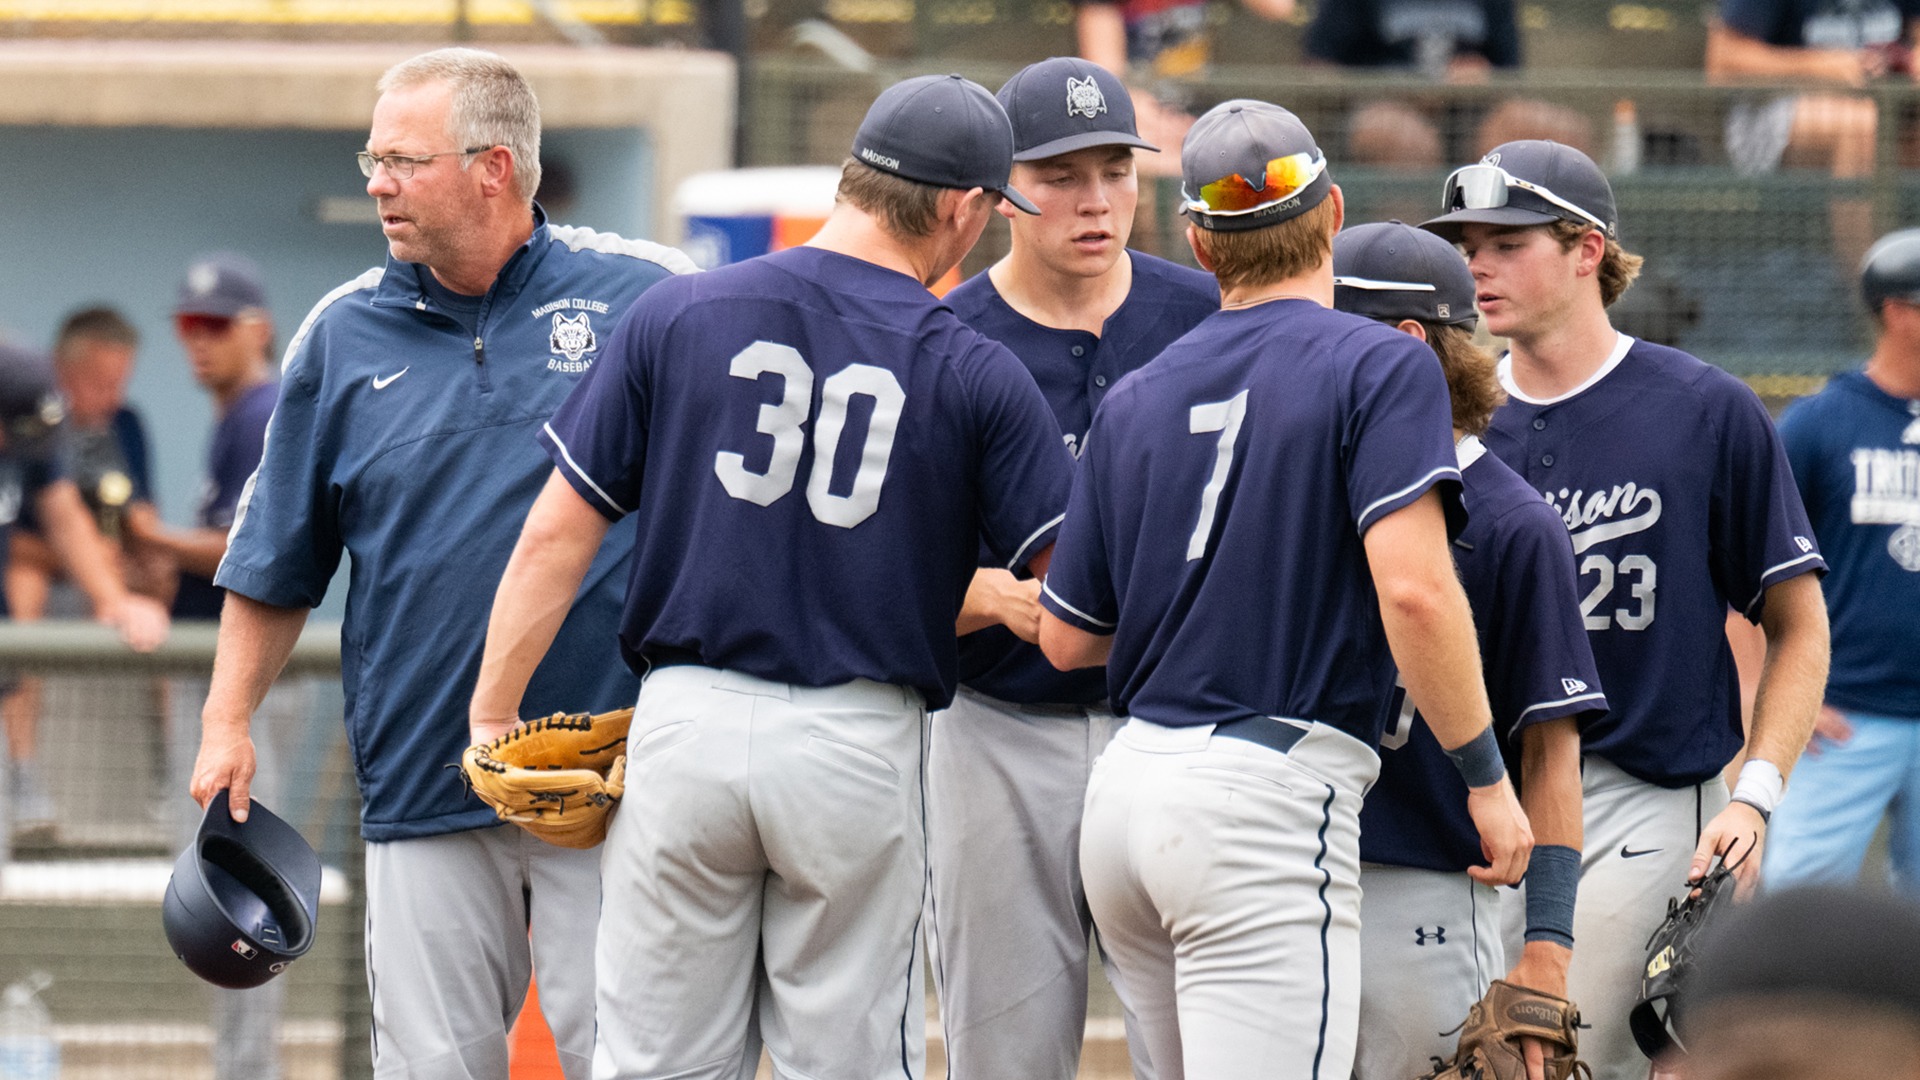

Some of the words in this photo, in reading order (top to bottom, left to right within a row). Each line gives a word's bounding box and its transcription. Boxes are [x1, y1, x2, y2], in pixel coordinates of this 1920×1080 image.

[861, 147, 900, 170] MADISON
[531, 298, 571, 319] MADISON
[572, 298, 610, 314] COLLEGE
[546, 357, 597, 373] BASEBA
[714, 340, 907, 528] 30
[1187, 387, 1250, 562] 7
[1579, 554, 1657, 631] 23
[1514, 1004, 1563, 1027] Wilson
